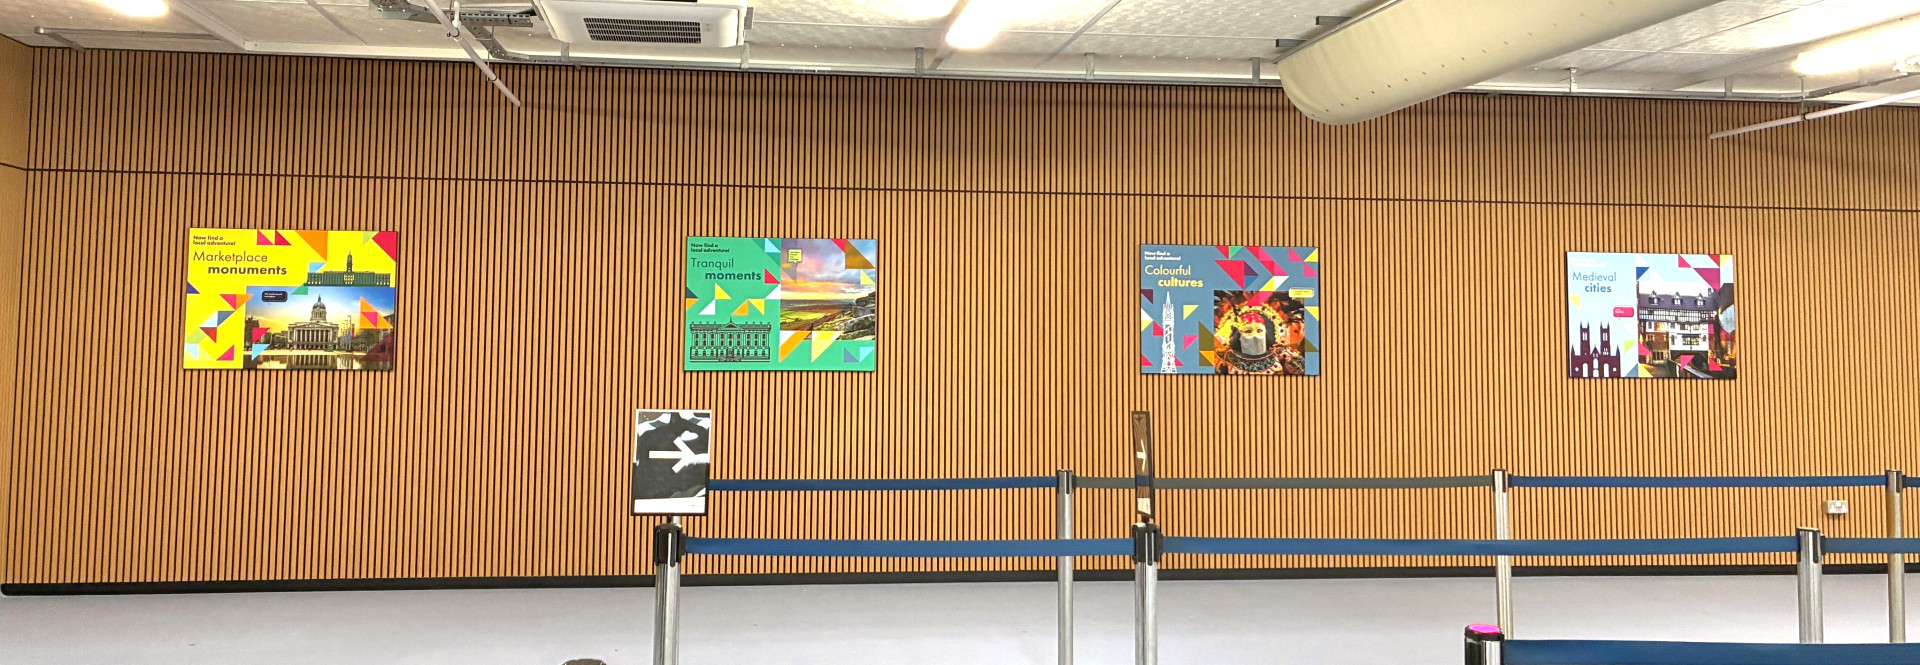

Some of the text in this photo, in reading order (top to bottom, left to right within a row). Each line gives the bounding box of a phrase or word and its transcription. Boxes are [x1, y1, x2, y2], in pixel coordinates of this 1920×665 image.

[193, 250, 268, 265] Marketplace
[690, 257, 734, 271] Tranquil
[208, 265, 287, 275] monuments
[1144, 264, 1191, 276] Colourful
[705, 271, 762, 281] moments
[1572, 271, 1617, 281] Medieval
[1157, 276, 1204, 288] cultures
[1584, 282, 1612, 293] cities
